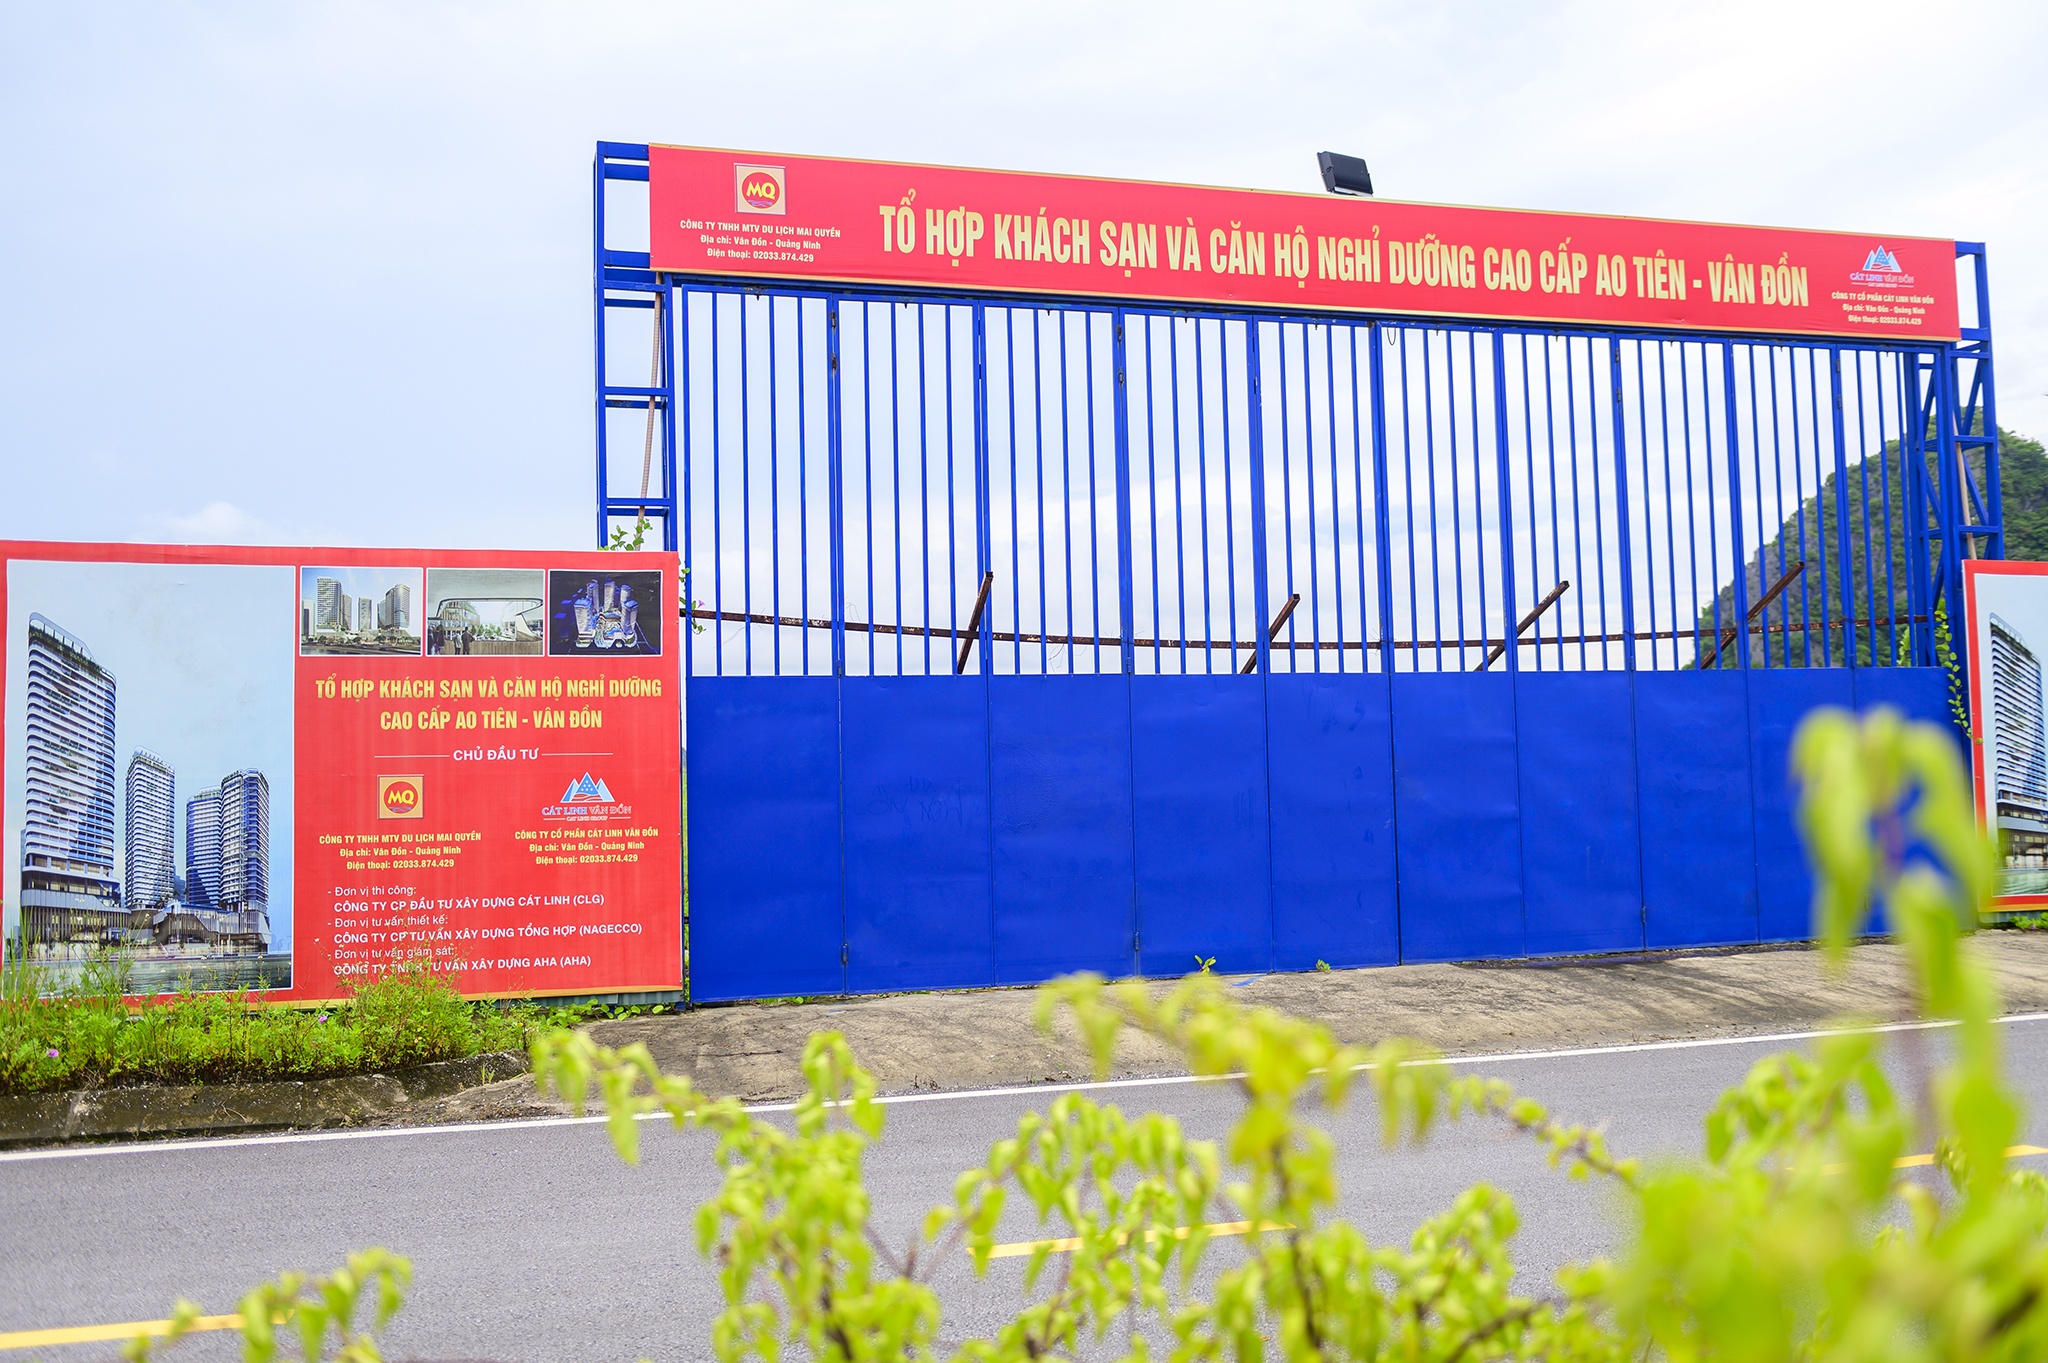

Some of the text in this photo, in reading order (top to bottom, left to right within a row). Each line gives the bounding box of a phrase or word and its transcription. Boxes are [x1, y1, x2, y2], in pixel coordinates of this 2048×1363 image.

[746, 181, 775, 199] MQ
[680, 219, 702, 229] CÔNG
[706, 222, 715, 230] TY
[718, 223, 739, 232] TNHH
[742, 224, 759, 233] MTV
[762, 225, 773, 233] DU
[776, 226, 794, 235] LỊCH
[797, 227, 811, 235] MAI
[879, 187, 1809, 307] TỔ HỢP KHÁCH SẠN VÀ CĂN HỘ NGHỈ DƯỠNG CAO CẤP AO TIÊN - VÂN ĐỒN
[728, 250, 750, 260] thoại:
[753, 251, 814, 262] 02033.874.429
[316, 673, 662, 702] TỔ HỢP KHÁCH SẠN VÀ CĂN HỘ NGHỈ DƯỠNG
[380, 711, 413, 730] CAO
[418, 705, 450, 730] CẤP
[455, 711, 477, 729] AO
[482, 707, 517, 729] TIÊN
[533, 707, 565, 728] VÂN
[569, 704, 602, 728] ĐỒN
[453, 745, 539, 761] CHỦ ĐẦU TƯ
[388, 790, 414, 805] MQ
[541, 805, 562, 815] CÁT
[564, 806, 587, 815] LINH
[319, 834, 342, 844] CÔNG
[345, 835, 355, 843] TY
[357, 835, 379, 843] TNHH
[382, 835, 399, 843] MTV
[402, 834, 413, 842] DU
[416, 833, 434, 844] LỊCH
[437, 833, 452, 841] MAI
[515, 830, 537, 840] CÔNG
[539, 830, 548, 839] TY
[588, 828, 602, 838] CÁT
[625, 829, 640, 837] VÂN
[368, 861, 390, 871] thoại:
[393, 859, 454, 869] 02033.874.429
[556, 856, 577, 866] thoại:
[580, 854, 638, 864] 02033.874.429
[335, 887, 356, 896] Đơn
[360, 887, 369, 897] vị
[372, 886, 384, 895] thi
[388, 887, 416, 896] công:
[334, 894, 604, 912] CÔNG TY CP ĐẦU TƯ XÂY DỰNG CÁT LINH (CLG)
[335, 918, 356, 927] Đơn
[360, 918, 369, 929] vị
[372, 918, 382, 926] tư
[407, 916, 429, 925] thiết
[433, 915, 448, 924] kế:
[334, 922, 642, 943] CÔNG TY CP TƯ VẤN XÂY DỰNG TỔNG HỢP (NAGECCO)
[335, 949, 356, 958] Đơn
[360, 949, 369, 960] vị
[372, 949, 383, 958] tư
[372, 965, 386, 973] TY
[428, 963, 441, 971] Ư
[444, 959, 468, 971] VẤN
[472, 958, 494, 970] XÂY
[498, 958, 530, 969] DỰNG
[534, 958, 557, 967] AHA
[560, 956, 591, 967] (AHA)
